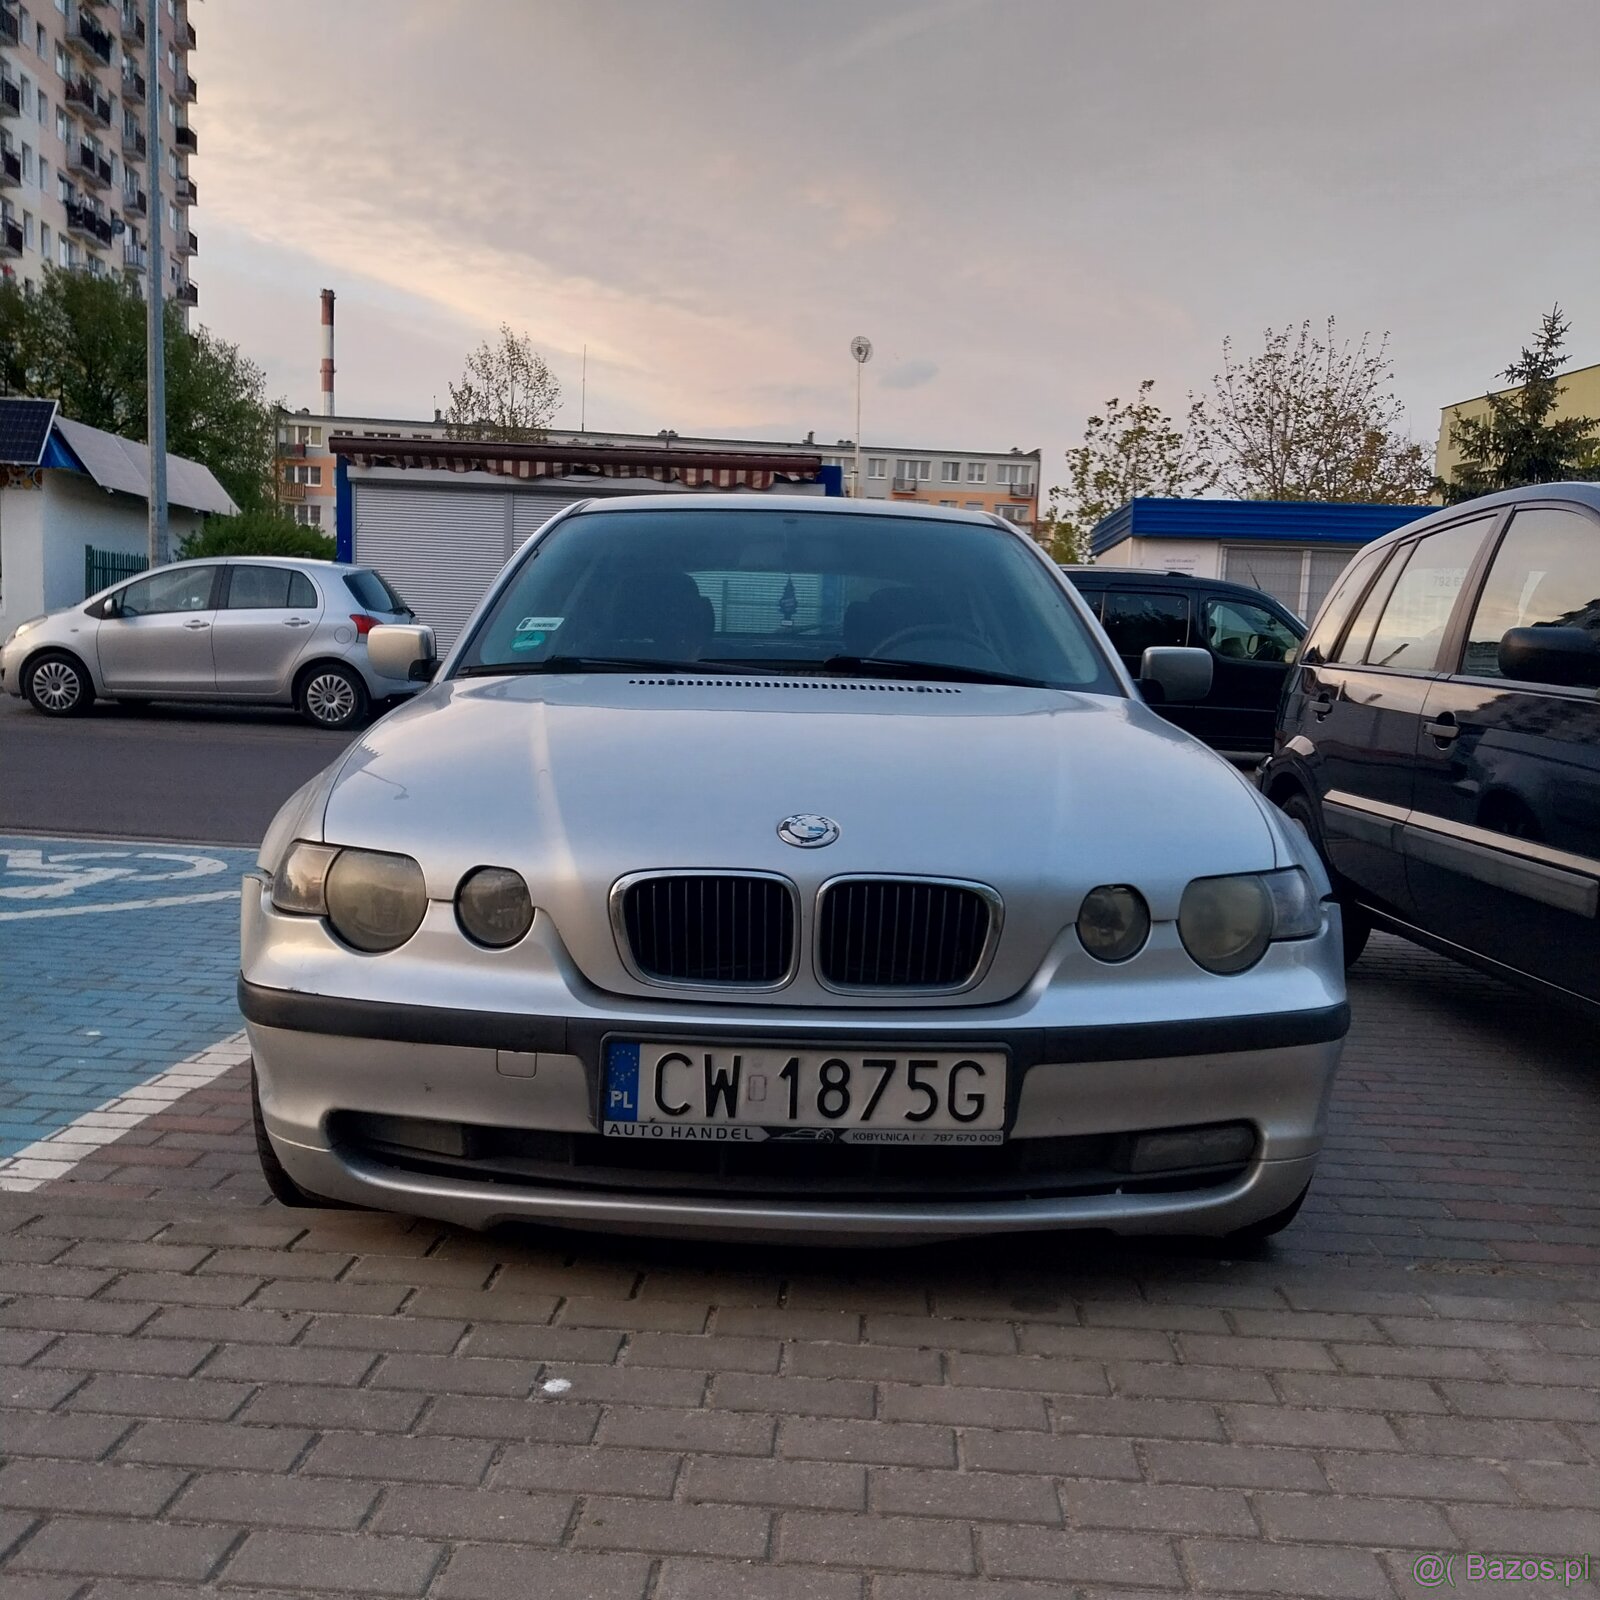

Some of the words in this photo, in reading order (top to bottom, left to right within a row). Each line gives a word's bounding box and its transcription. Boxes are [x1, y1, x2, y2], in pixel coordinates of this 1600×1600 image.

[655, 1052, 741, 1118] CW
[779, 1057, 985, 1122] 1875G
[610, 1090, 633, 1108] PL
[609, 1123, 663, 1137] AUTO
[671, 1126, 753, 1140] HANDEL
[933, 1133, 954, 1142] 787
[956, 1133, 977, 1142] 670
[980, 1134, 1002, 1143] 009
